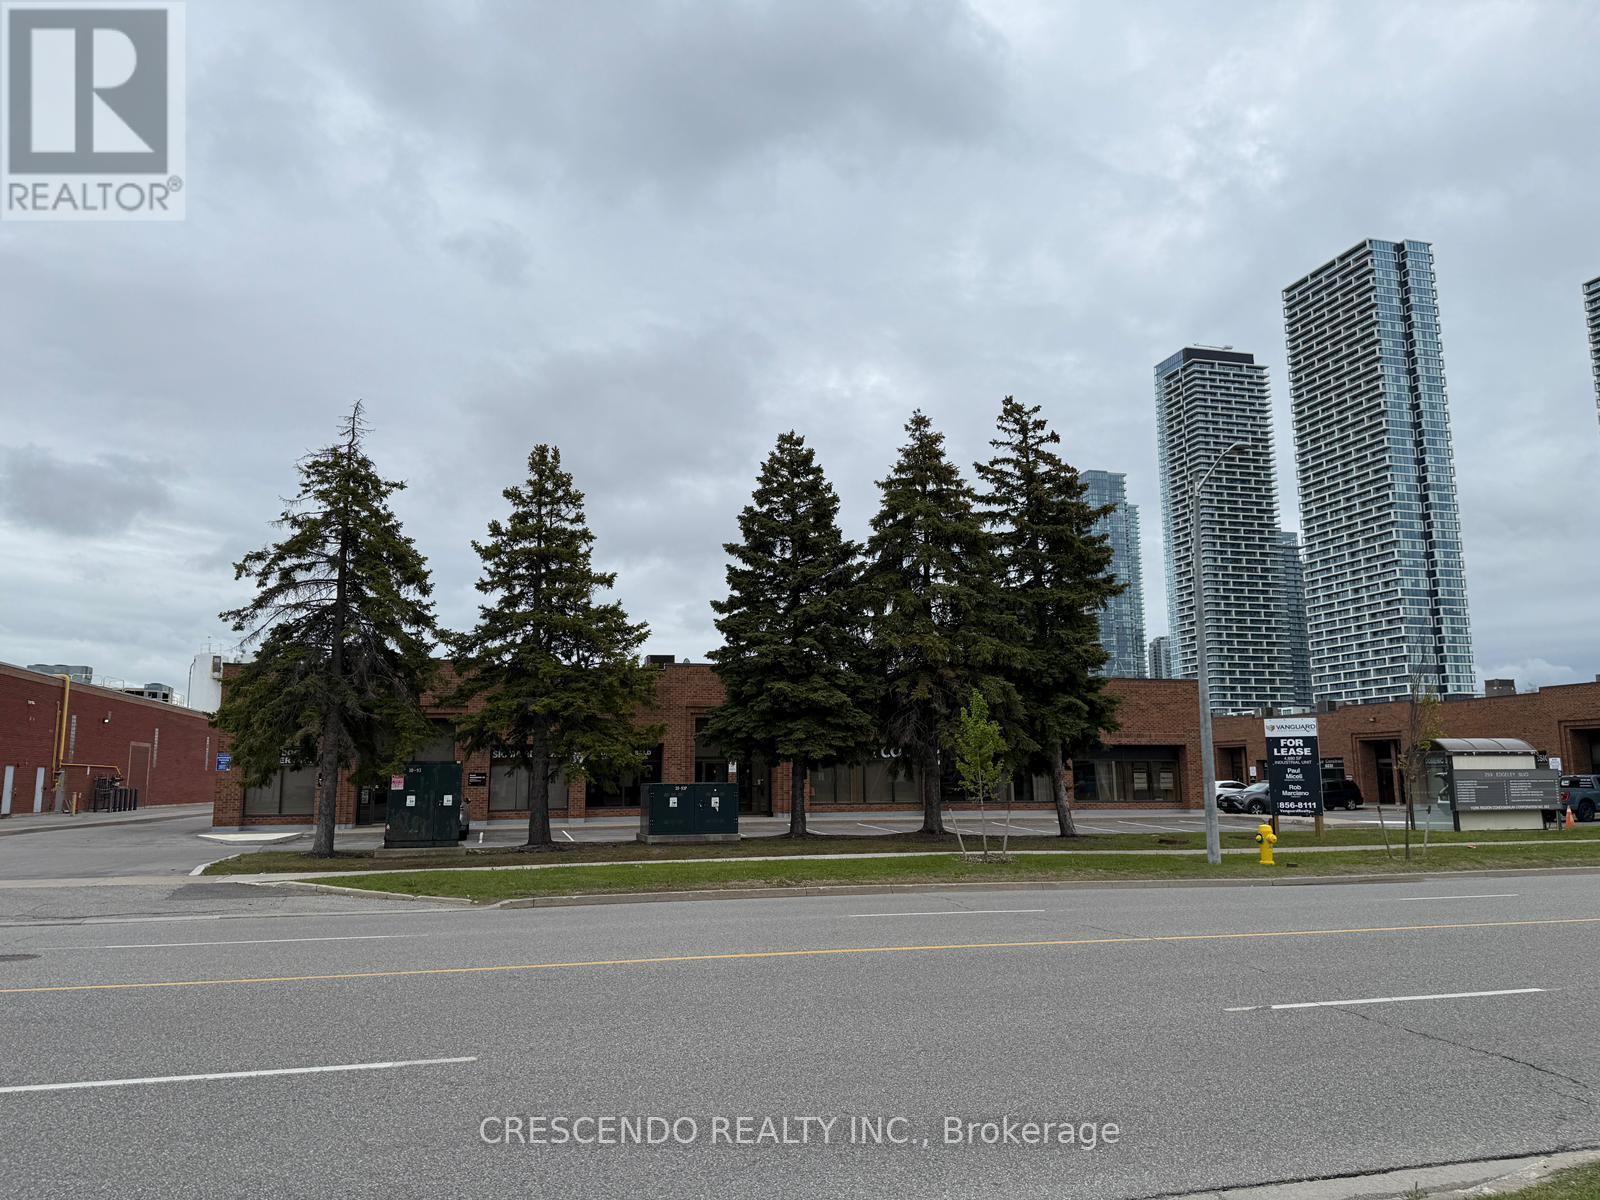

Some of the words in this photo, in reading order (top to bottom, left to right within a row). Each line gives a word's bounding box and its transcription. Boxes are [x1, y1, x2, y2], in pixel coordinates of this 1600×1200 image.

[1275, 724, 1316, 733] VANGUARD
[1280, 738, 1304, 747] FOR
[1273, 747, 1312, 756] LEASE
[1279, 801, 1317, 809] 856-8111
